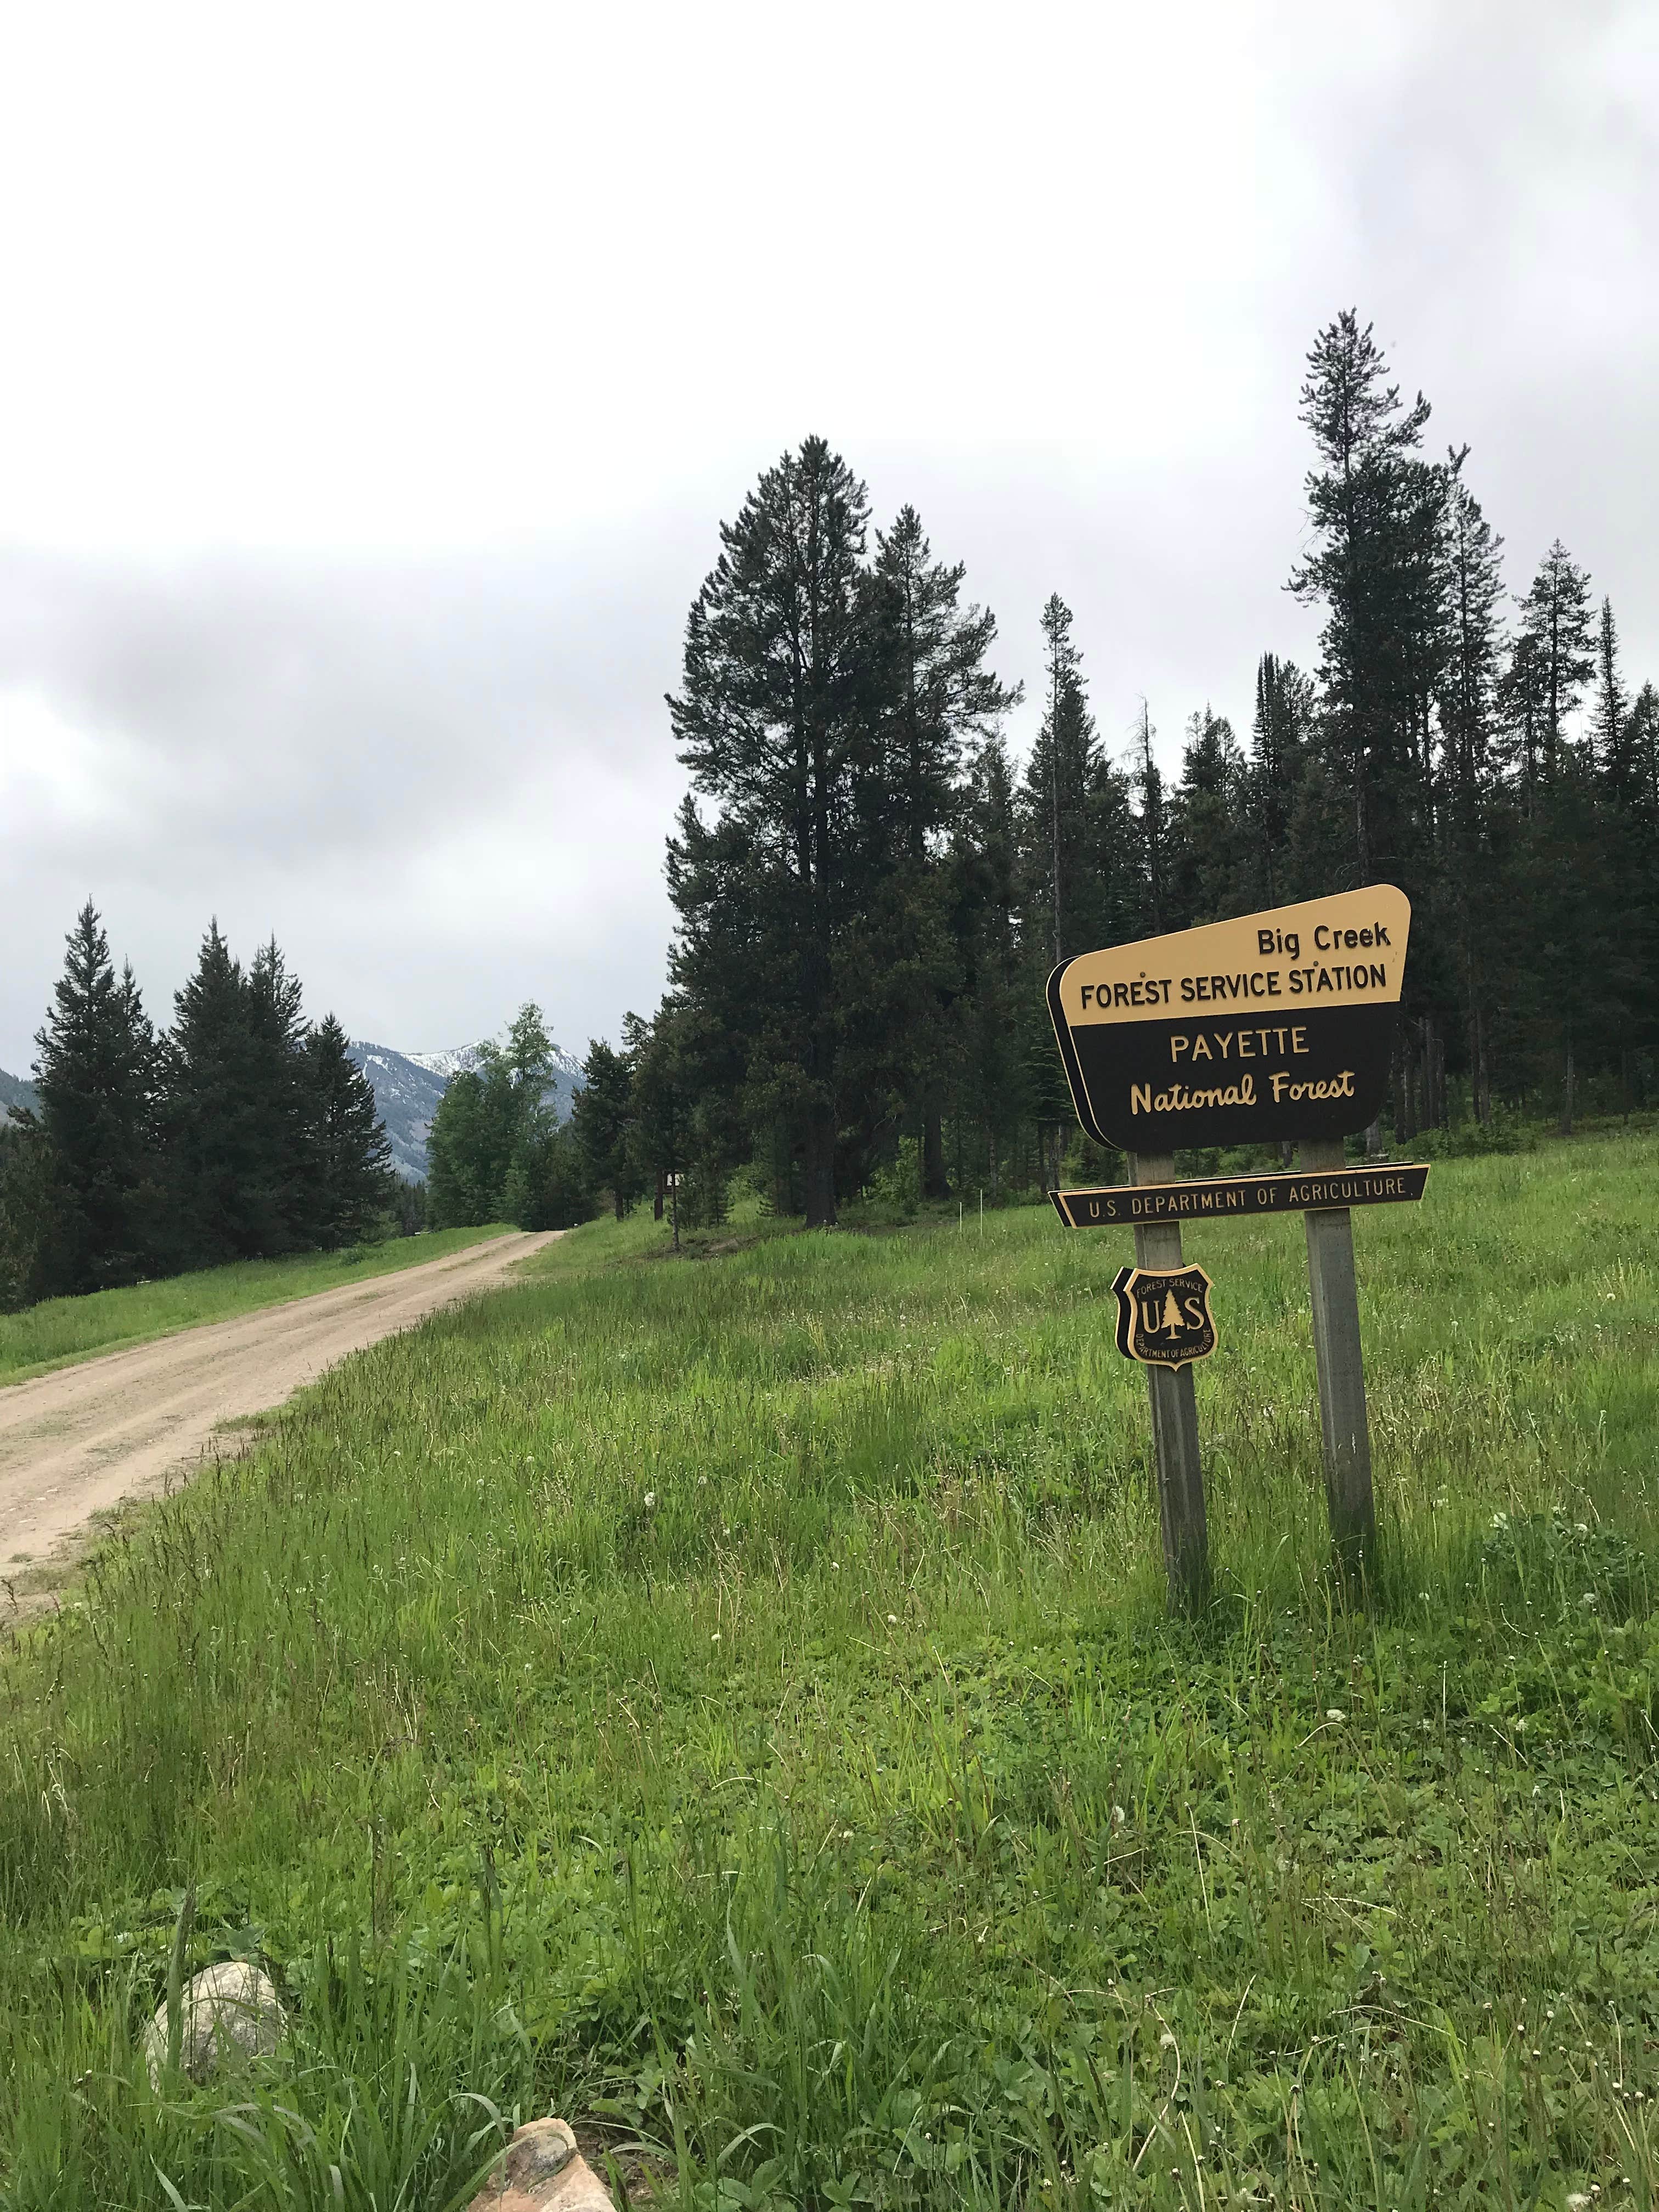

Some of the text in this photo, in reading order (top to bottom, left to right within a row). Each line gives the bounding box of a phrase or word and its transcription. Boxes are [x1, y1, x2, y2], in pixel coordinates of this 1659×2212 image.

[1257, 922, 1391, 961] Big Creek
[1081, 964, 1386, 1009] FOREST SERVICE STATION
[1170, 1026, 1309, 1063] PAYETTE
[1130, 1070, 1356, 1115] National Forest
[1089, 1177, 1406, 1218] U.S. DEPARTMENT OF AGRICULTURE
[1137, 1279, 1203, 1298] FOREST SERVICE
[1136, 1329, 1211, 1358] DEPARTMENT OF AGRICULTURE
